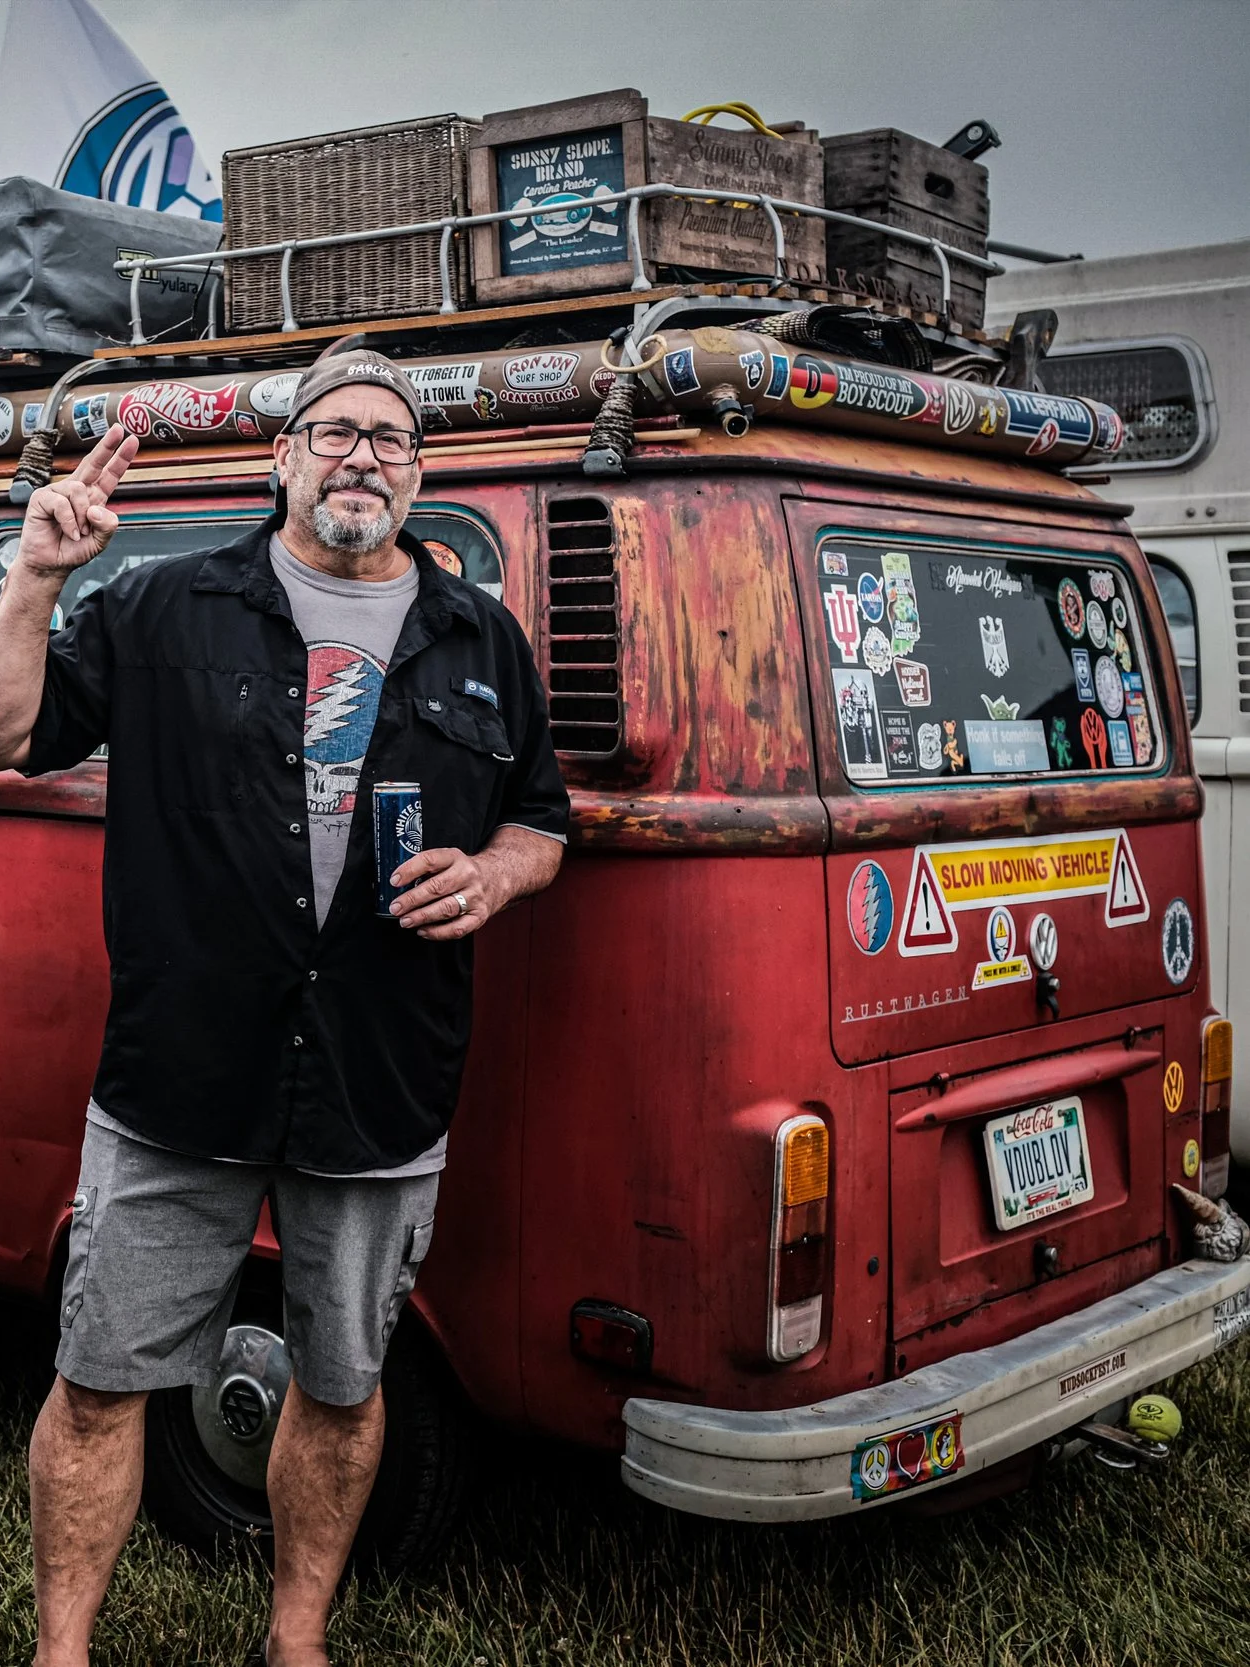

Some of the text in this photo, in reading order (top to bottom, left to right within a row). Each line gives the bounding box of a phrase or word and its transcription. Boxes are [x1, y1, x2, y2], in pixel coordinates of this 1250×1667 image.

[511, 147, 560, 170] SUNNY
[535, 160, 584, 182] BRAND
[523, 177, 598, 198] Carolina Peaches
[160, 277, 199, 294] yulara
[422, 366, 460, 380] FORGET
[462, 366, 475, 378] TO
[510, 356, 573, 375] RON JON
[515, 372, 562, 383] SURF SHOP
[804, 363, 822, 398] D
[838, 366, 912, 395] I'M PROUD OF MY
[424, 387, 431, 402] A
[432, 386, 466, 402] TOWEL
[500, 386, 580, 404] ORANGE BEACH
[837, 382, 914, 416] BOY SCOUT
[1006, 392, 1087, 423] TYLERFALIA
[395, 804, 414, 837] WHITE
[941, 851, 1110, 890] SLOW MOVING VEHICLE
[845, 985, 966, 1020] RUSTWAGEN
[1060, 1352, 1126, 1397] MUDSOCKFEST.COM
